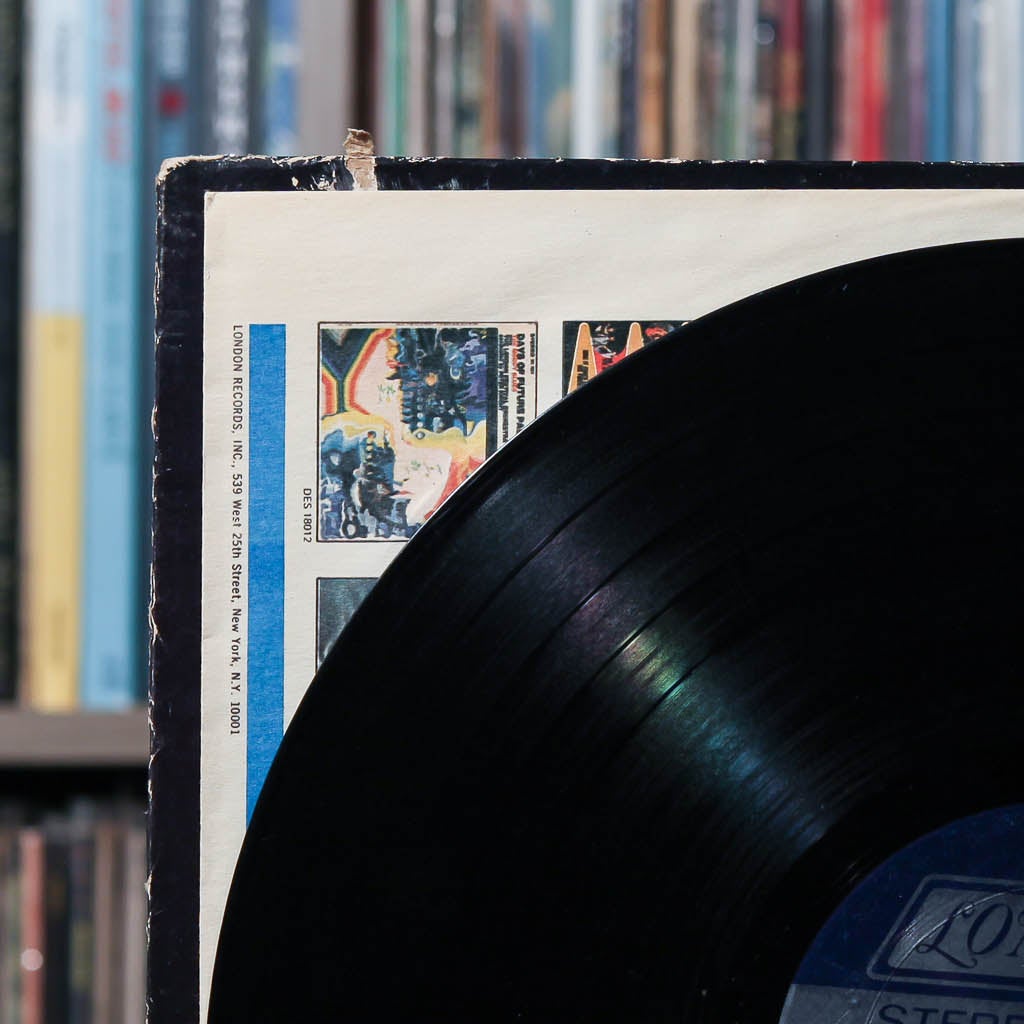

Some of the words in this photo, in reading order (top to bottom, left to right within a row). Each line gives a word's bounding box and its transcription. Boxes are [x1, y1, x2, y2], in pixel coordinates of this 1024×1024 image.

[232, 324, 244, 372] LONDON
[516, 333, 526, 360] DAYS
[516, 361, 526, 375] OF
[231, 376, 244, 434] RECORDS,
[516, 377, 526, 414] FUTURE
[231, 440, 244, 468] INC.,
[231, 473, 243, 495] 539
[303, 488, 312, 509] DES
[231, 500, 242, 527] West
[302, 512, 312, 543] 18012
[231, 533, 242, 559] 25th
[230, 564, 242, 603] Street,
[231, 608, 241, 633] New
[229, 637, 241, 667] York,
[230, 672, 241, 695] N.Y.
[230, 701, 241, 736] 10001
